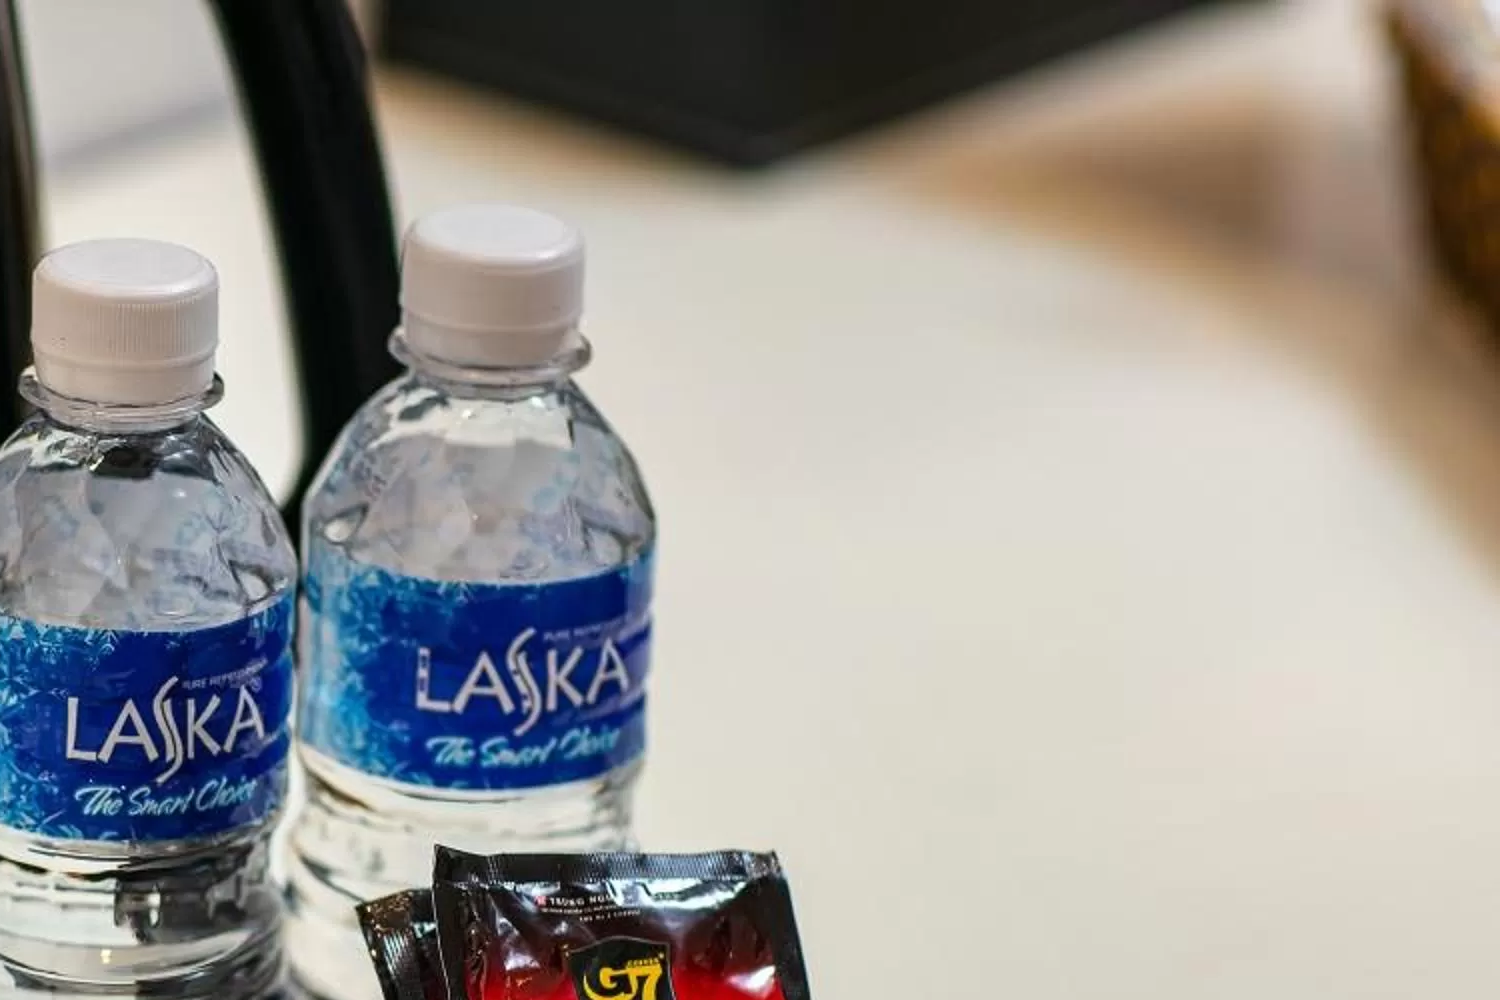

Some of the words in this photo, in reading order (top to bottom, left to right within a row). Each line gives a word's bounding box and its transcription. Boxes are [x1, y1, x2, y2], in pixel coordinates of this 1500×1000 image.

[66, 675, 266, 785] LASKA
[415, 626, 631, 737] LASKA
[74, 785, 123, 816] The
[127, 786, 196, 817] Smart
